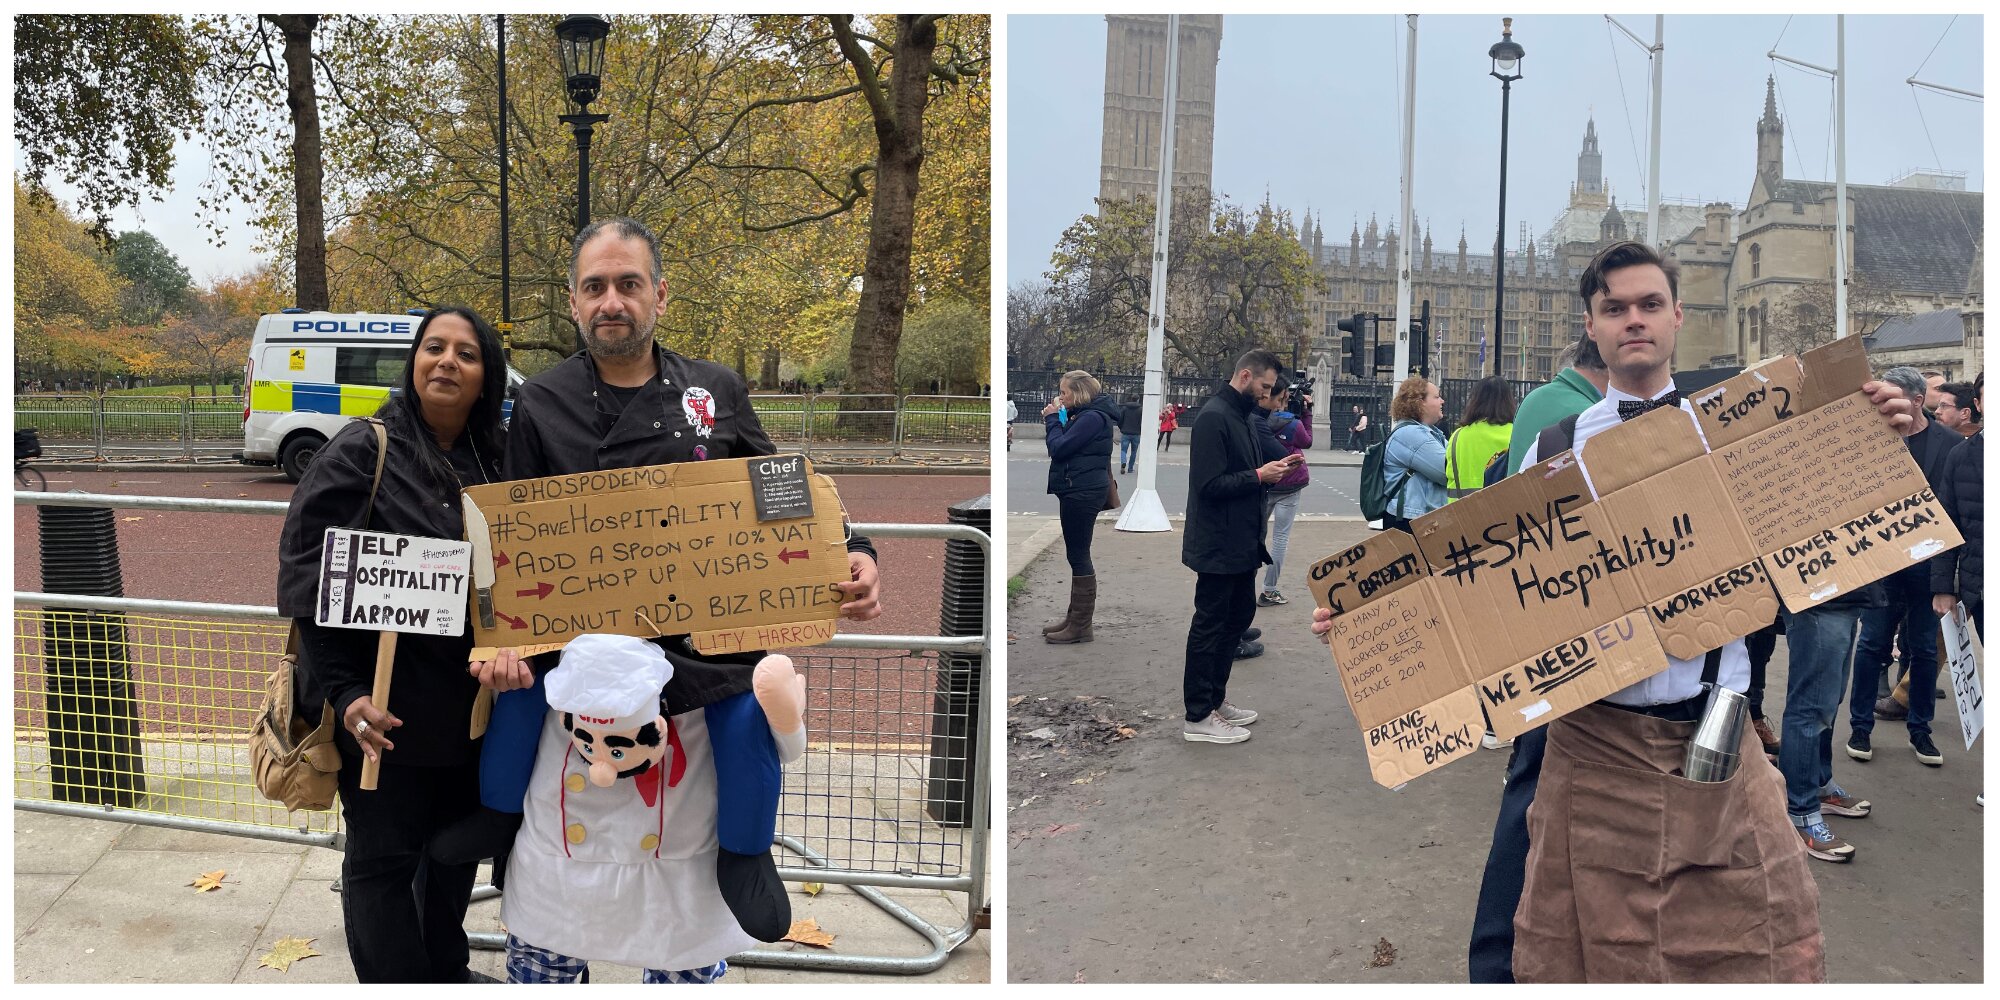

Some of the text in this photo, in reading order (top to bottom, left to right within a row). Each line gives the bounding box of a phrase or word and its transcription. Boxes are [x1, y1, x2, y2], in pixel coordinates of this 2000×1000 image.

[292, 320, 411, 334] POLICE
[254, 380, 270, 388] LMR
[1700, 391, 1724, 416] MY
[685, 413, 703, 426] Red
[1717, 385, 1767, 429] STORY
[1802, 420, 1841, 442] WORKER
[1842, 403, 1877, 426] LIVING
[1722, 447, 1743, 466] MY
[1795, 419, 1809, 431] IS
[1812, 414, 1821, 423] A
[1731, 479, 1749, 493] IN
[1791, 449, 1811, 464] SHE
[1812, 435, 1841, 453] LOVES
[1845, 425, 1866, 437] THE
[509, 468, 667, 502] @HOSPODEMO
[759, 458, 798, 475] Chef
[1736, 490, 1756, 504] SHE
[1776, 467, 1801, 483] LIVED
[1804, 456, 1822, 470] AND
[1825, 440, 1861, 459] WORKED
[1741, 503, 1755, 516] IN
[1759, 493, 1777, 505] THE
[1831, 462, 1840, 471] 2
[1868, 444, 1878, 454] OF
[1792, 490, 1810, 502] WE
[1816, 475, 1837, 494] WANT
[1841, 471, 1853, 480] TO
[1854, 462, 1870, 473] BE
[1786, 506, 1805, 518] THE
[1861, 470, 1883, 483] SHE
[1440, 493, 1592, 588] #SAVE
[1758, 532, 1776, 548] GET
[1780, 526, 1788, 536] A
[1817, 506, 1831, 517] SO
[1773, 488, 1937, 569] LOWER THE WAGE
[1797, 507, 1941, 585] FOR UK VISA!
[515, 522, 818, 578] ADD A SPOON OF 10% VAT
[1311, 543, 1367, 581] COVID
[1511, 512, 1695, 611] Hospitality!!
[560, 551, 769, 596] CHOP UP VISAS
[1357, 552, 1421, 599] BREXIT!
[532, 582, 845, 637] DONUT ADD BIZ RATES
[1333, 597, 1400, 639] AS MANY AS
[1348, 606, 1418, 650] 200,000 EU
[757, 622, 833, 648] HARROW
[1342, 615, 1441, 673] WORKERS LEFT UK
[1482, 560, 1767, 707] WE NEED EU WORKERS!
[1351, 640, 1426, 687] HOSPO SECTOR
[1353, 660, 1427, 704] SINCE 2019
[1369, 709, 1428, 747] BRING
[1392, 720, 1440, 753] THEM
[1422, 723, 1474, 765] BACK!
